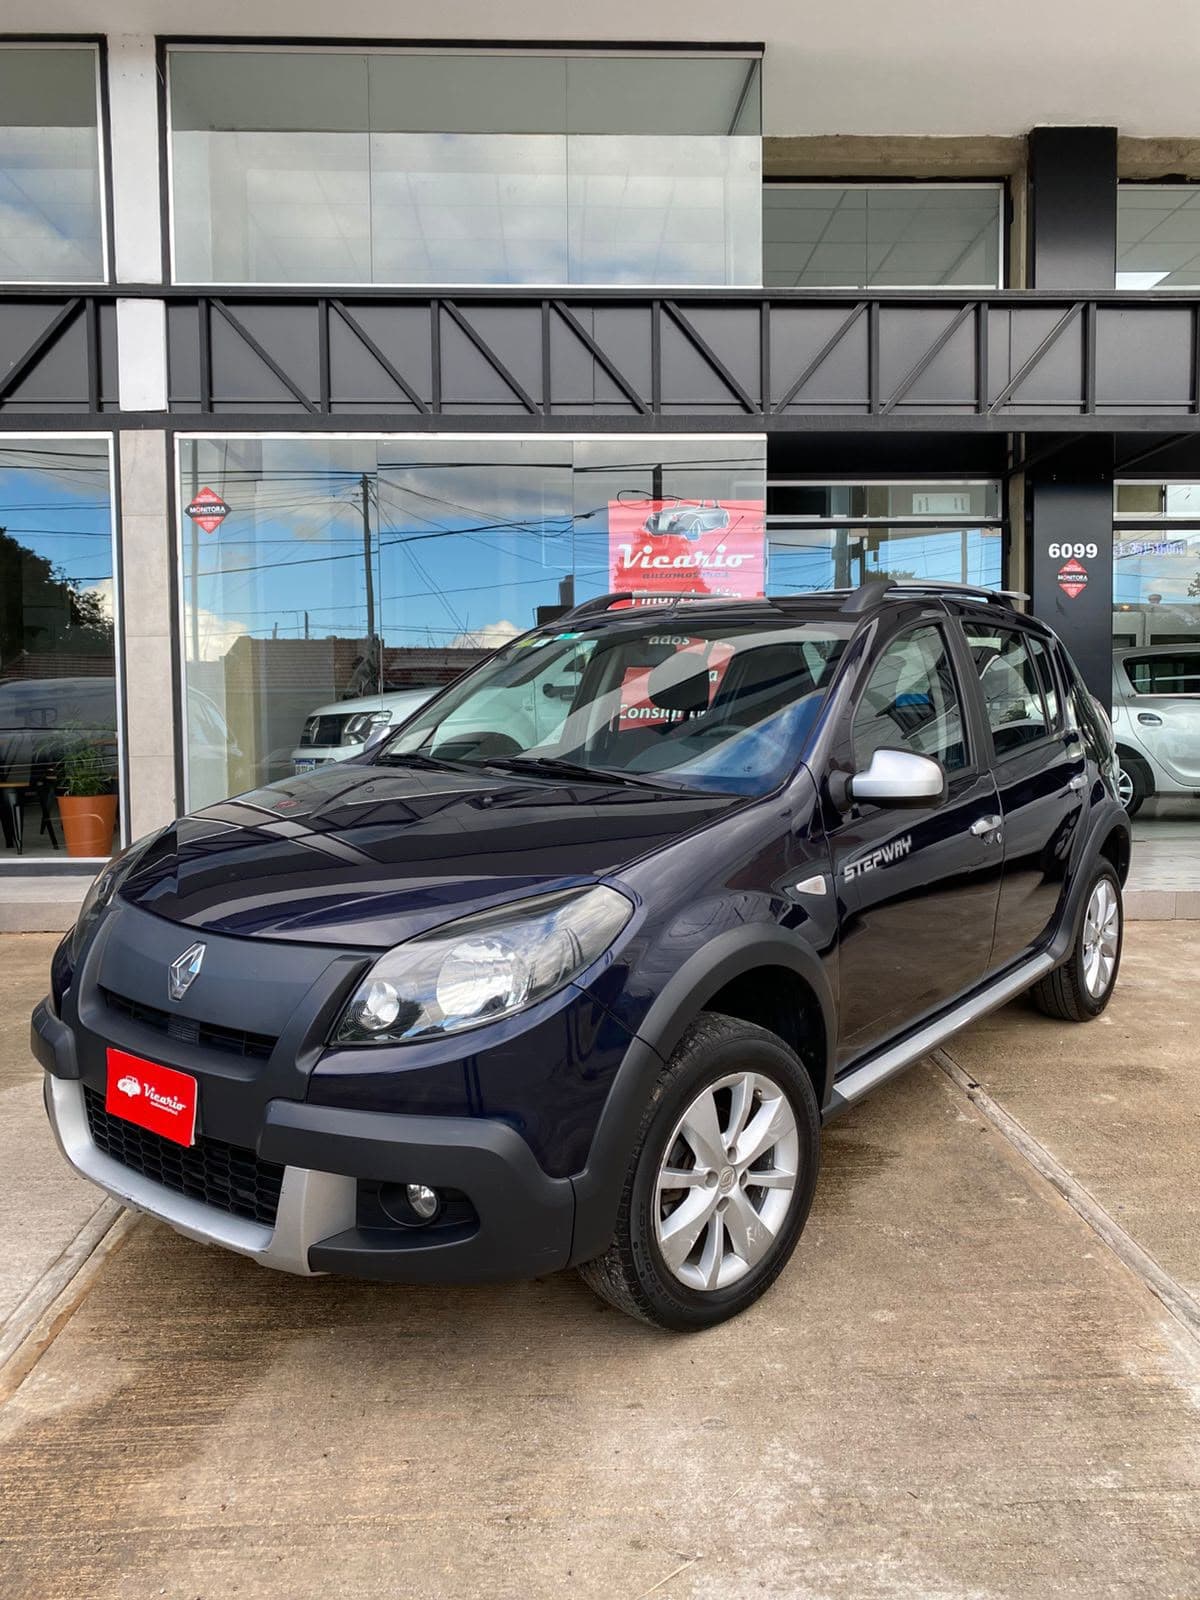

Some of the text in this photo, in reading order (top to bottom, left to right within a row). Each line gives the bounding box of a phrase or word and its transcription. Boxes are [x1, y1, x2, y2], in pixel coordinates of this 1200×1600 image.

[617, 545, 754, 569] Vicario
[1048, 543, 1098, 558] 6099
[844, 835, 912, 883] STEPWAY
[143, 1083, 187, 1111] Vicario
